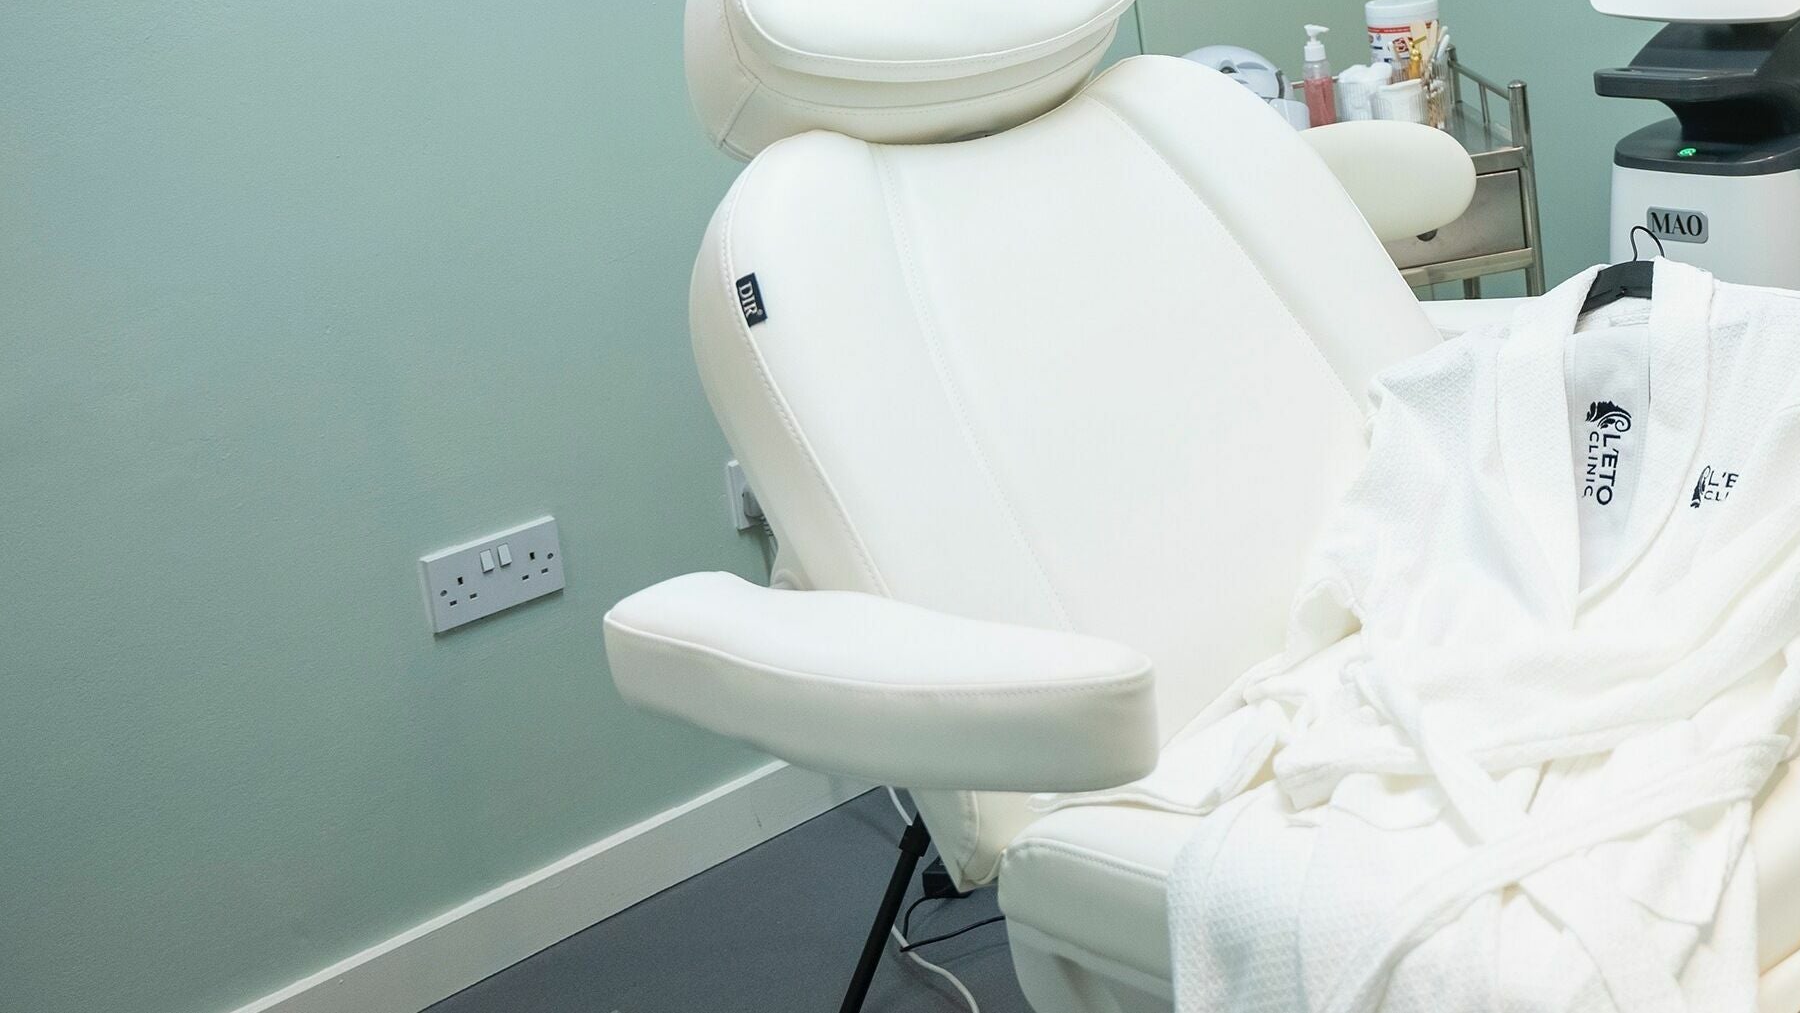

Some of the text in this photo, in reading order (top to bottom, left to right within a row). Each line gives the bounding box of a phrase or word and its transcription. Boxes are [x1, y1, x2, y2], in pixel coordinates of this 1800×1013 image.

[1651, 211, 1703, 237] MAO
[1582, 431, 1600, 498] CLINIC
[1596, 434, 1621, 506] L'ETO
[1708, 470, 1740, 488] L'E
